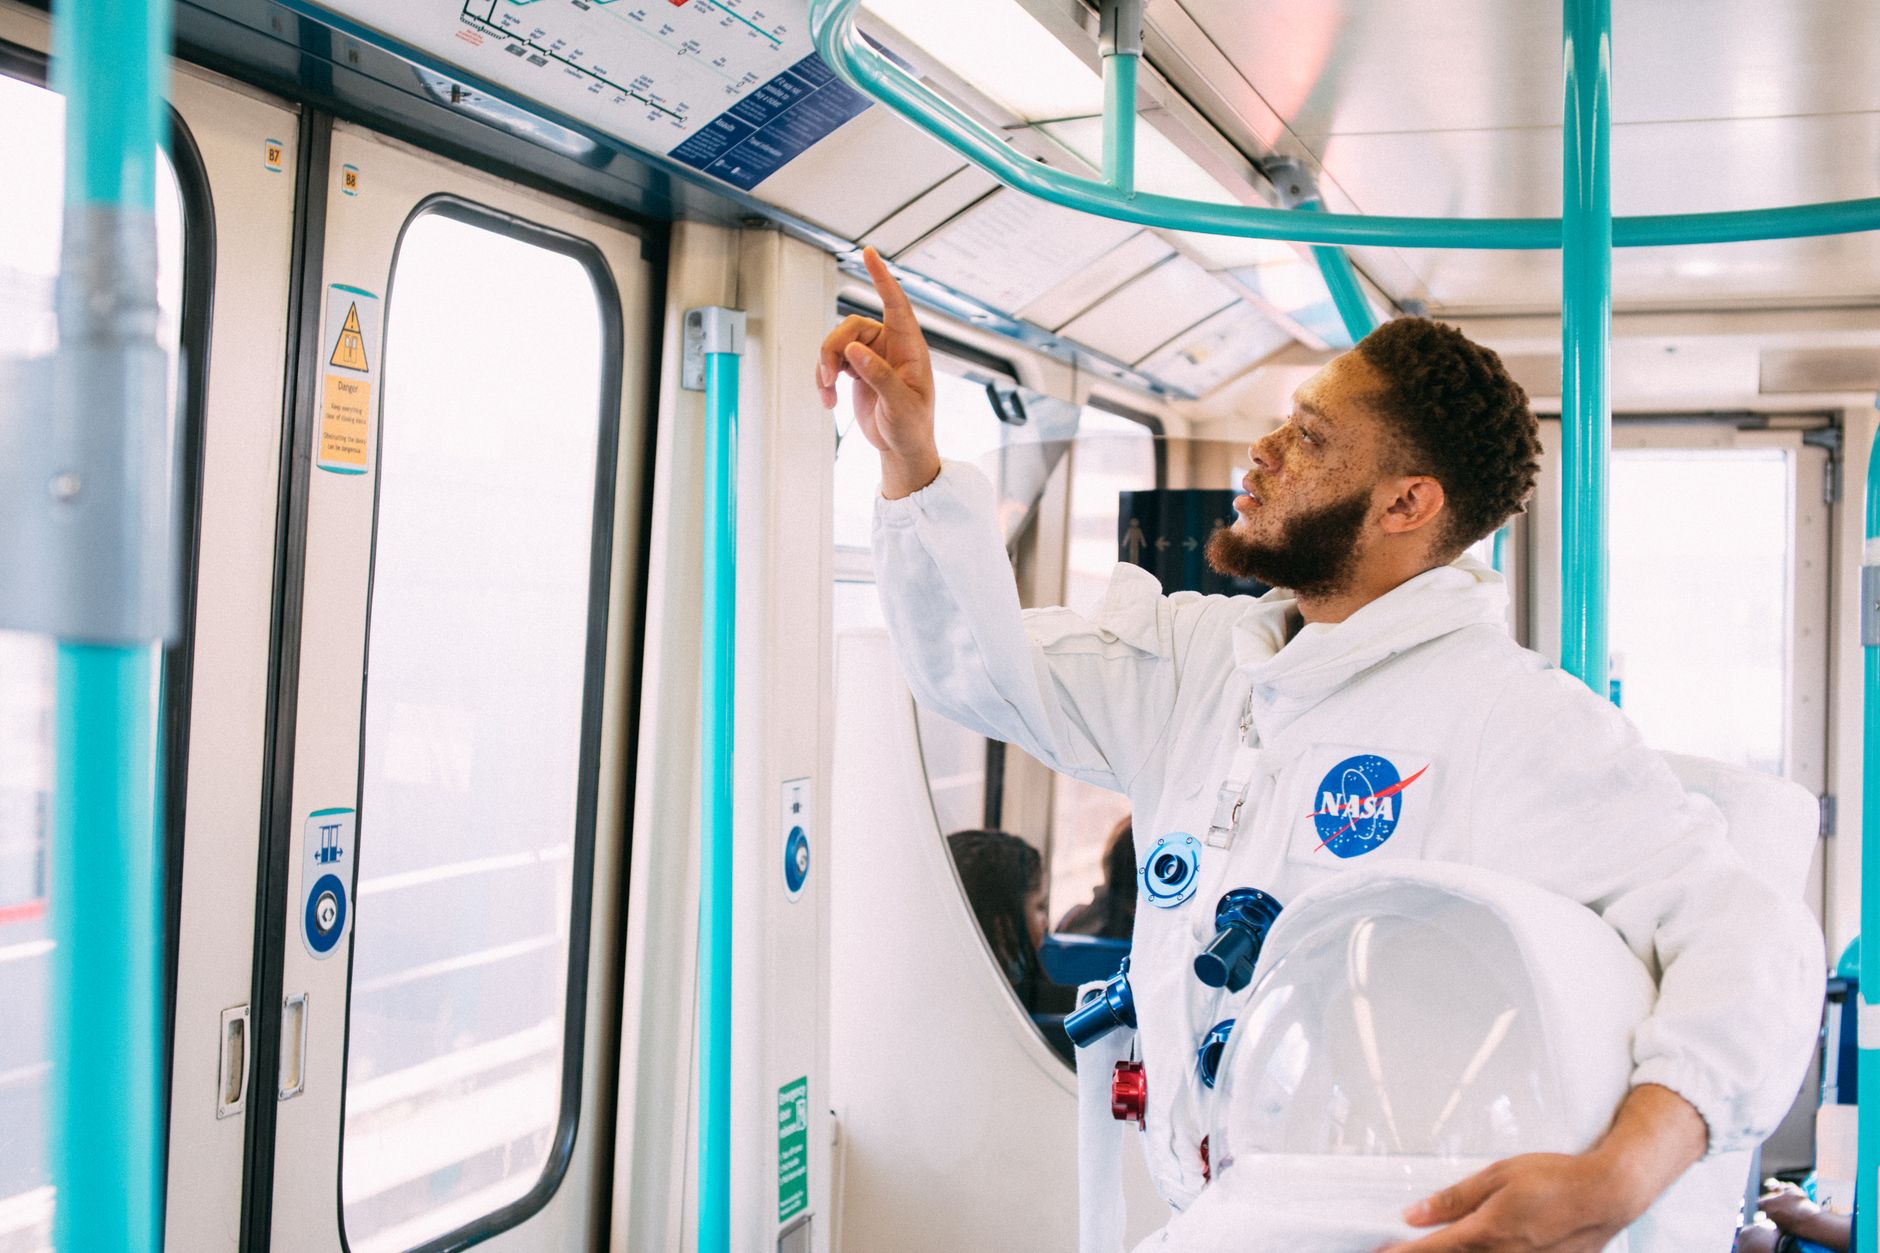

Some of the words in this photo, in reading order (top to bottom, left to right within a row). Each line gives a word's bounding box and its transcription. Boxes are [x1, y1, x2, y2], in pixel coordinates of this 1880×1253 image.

[269, 148, 280, 162] B7
[337, 381, 358, 394] Danger
[1320, 791, 1394, 821] NASA
